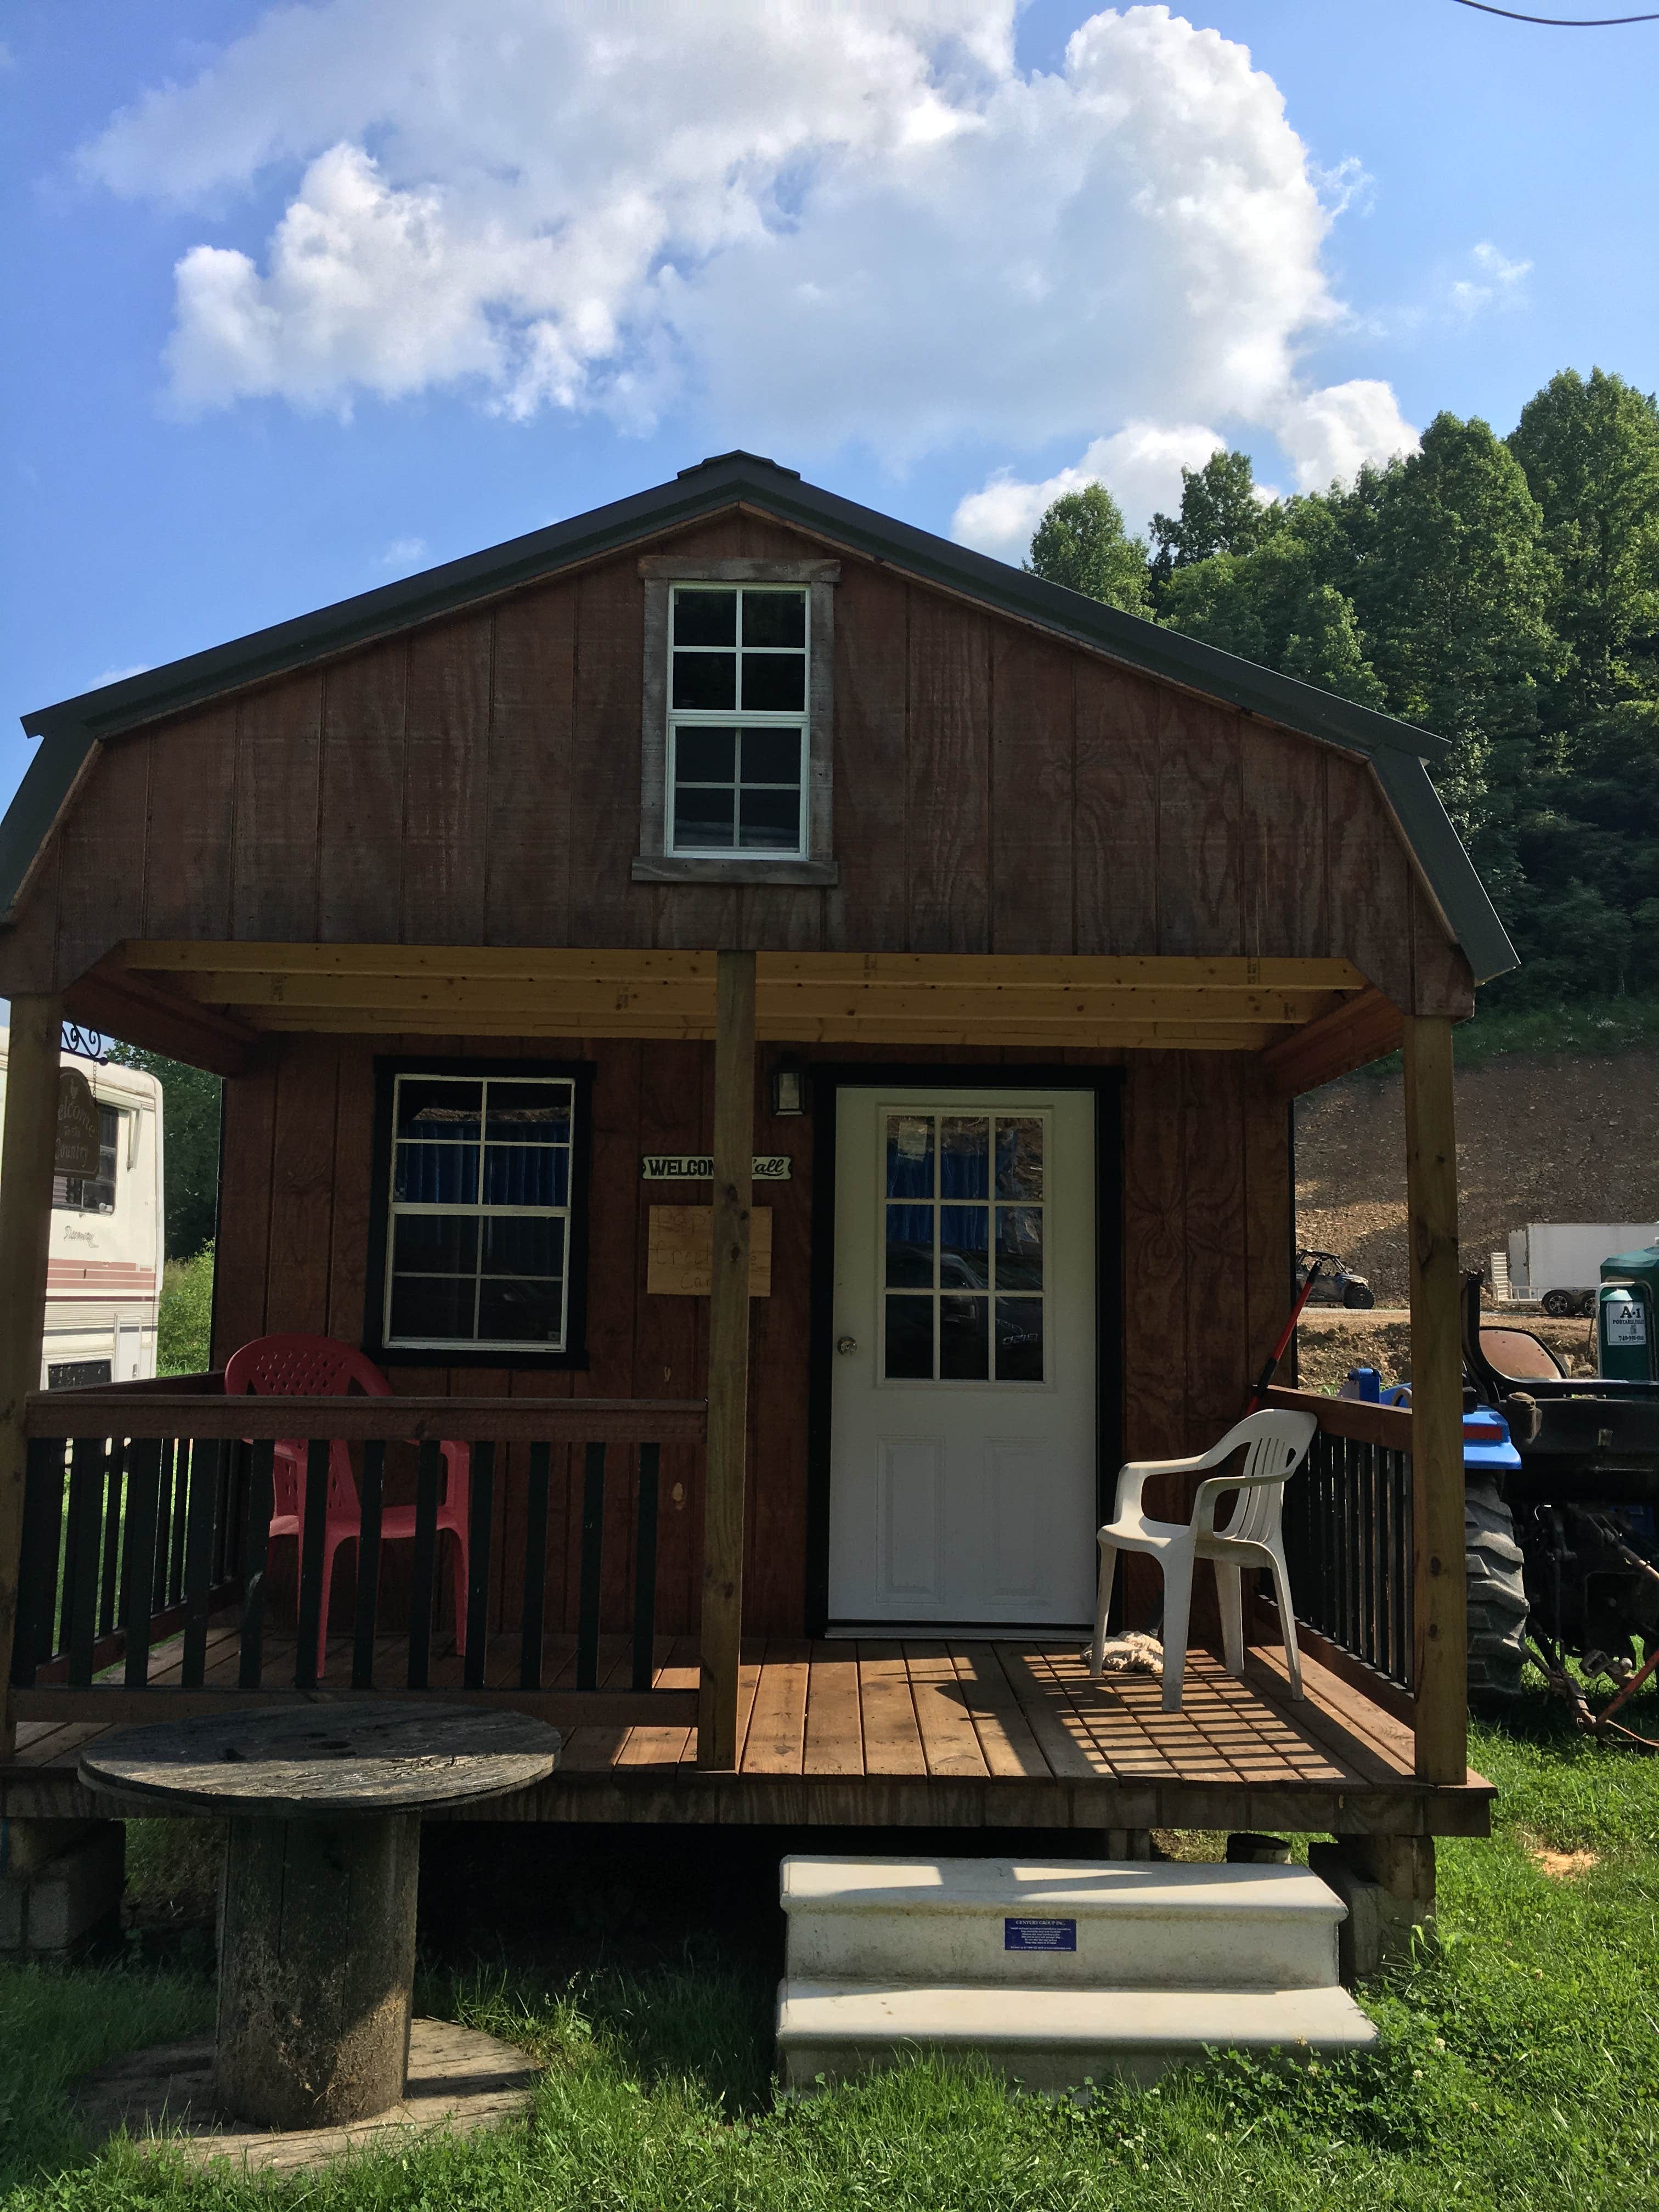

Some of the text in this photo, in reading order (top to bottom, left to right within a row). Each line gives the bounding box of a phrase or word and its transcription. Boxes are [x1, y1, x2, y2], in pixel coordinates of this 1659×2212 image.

[57, 1096, 95, 1137] elcome
[648, 1159, 784, 1176] WELCO 'all
[1620, 1306, 1641, 1318] A-1
